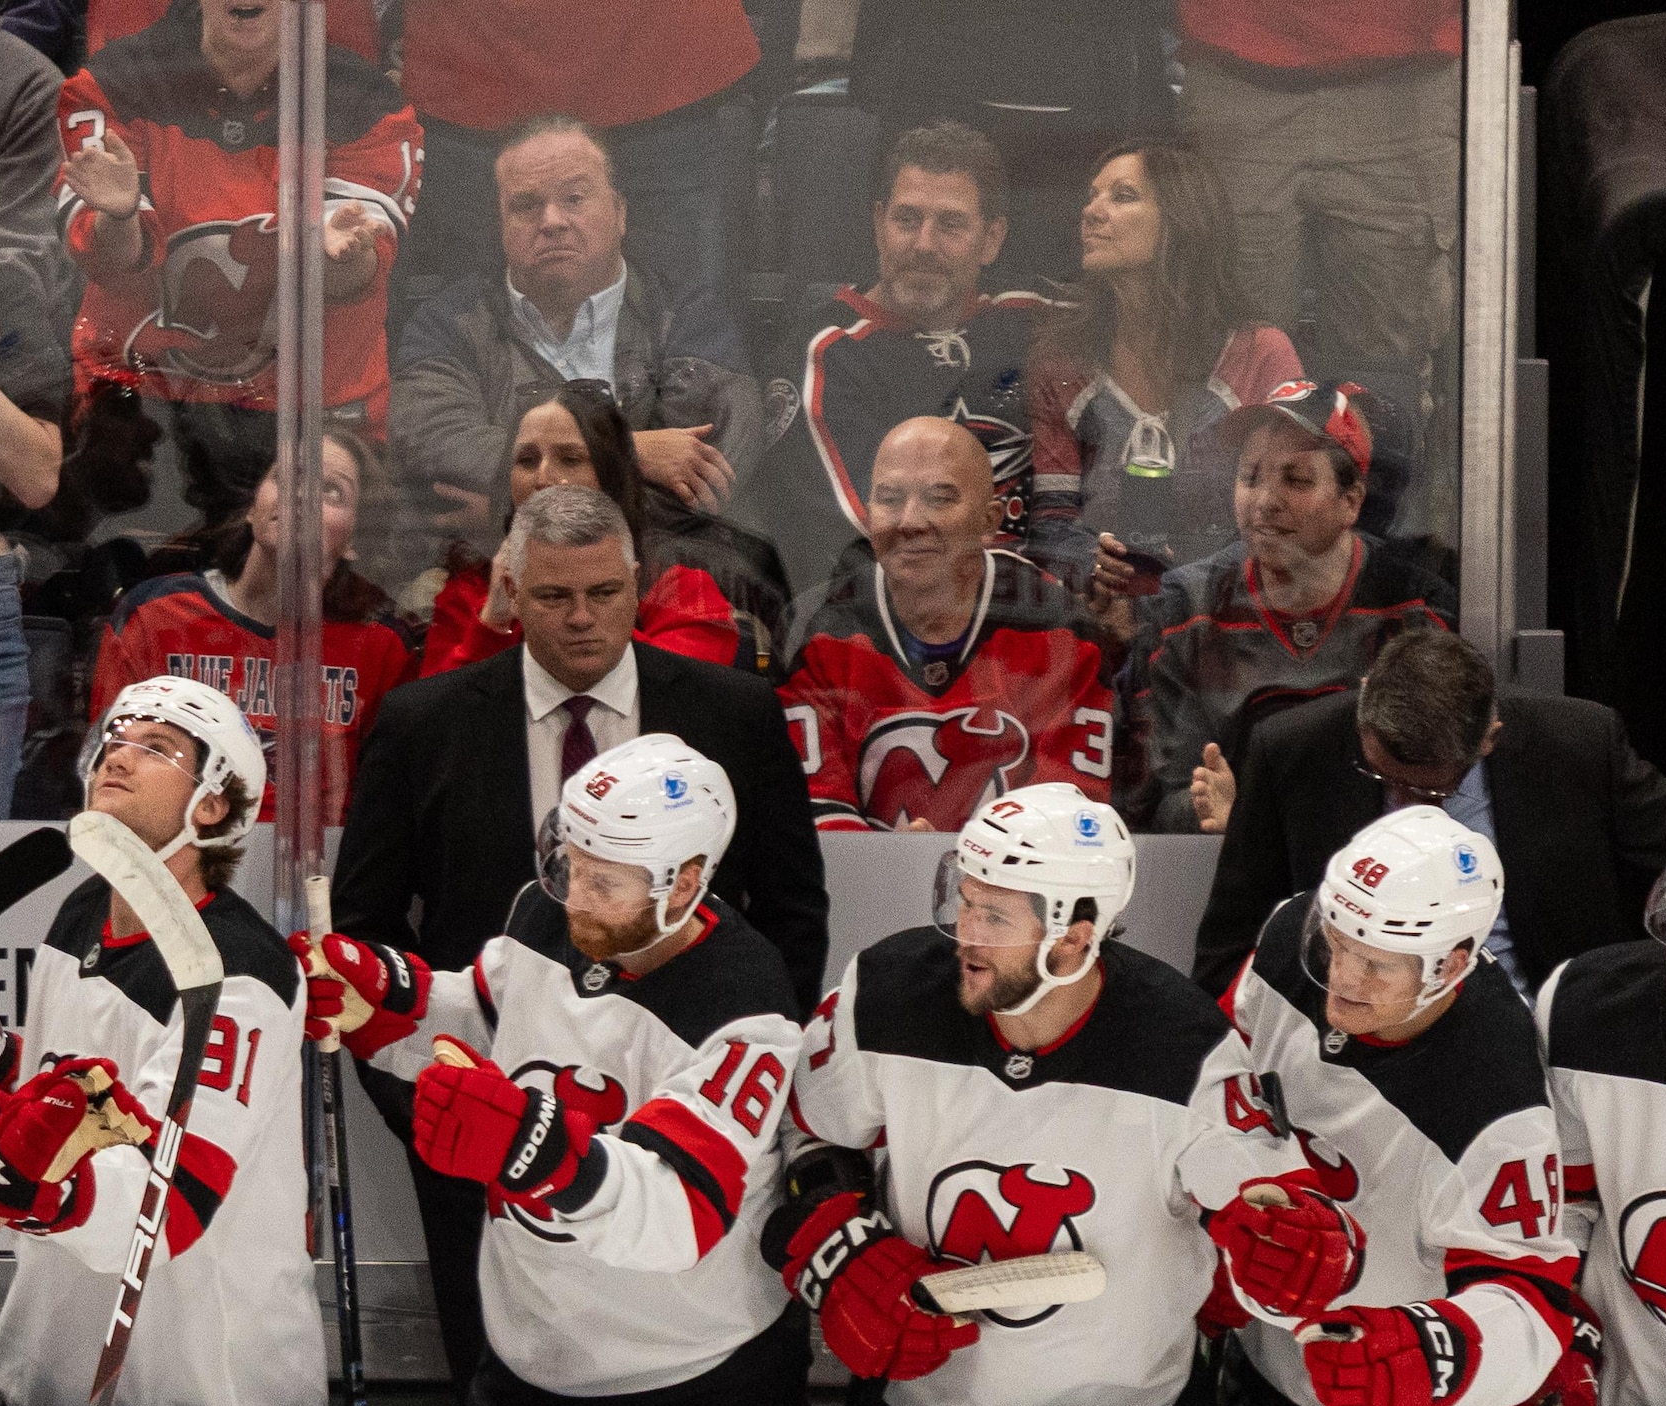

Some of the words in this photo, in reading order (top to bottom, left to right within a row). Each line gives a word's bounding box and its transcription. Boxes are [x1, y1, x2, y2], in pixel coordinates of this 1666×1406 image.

[963, 838, 993, 858] CCM
[1351, 856, 1390, 889] 48
[1333, 892, 1373, 919] CCM
[698, 1038, 787, 1139] 16
[105, 1114, 184, 1348] TRUE
[795, 1210, 895, 1311] CCM
